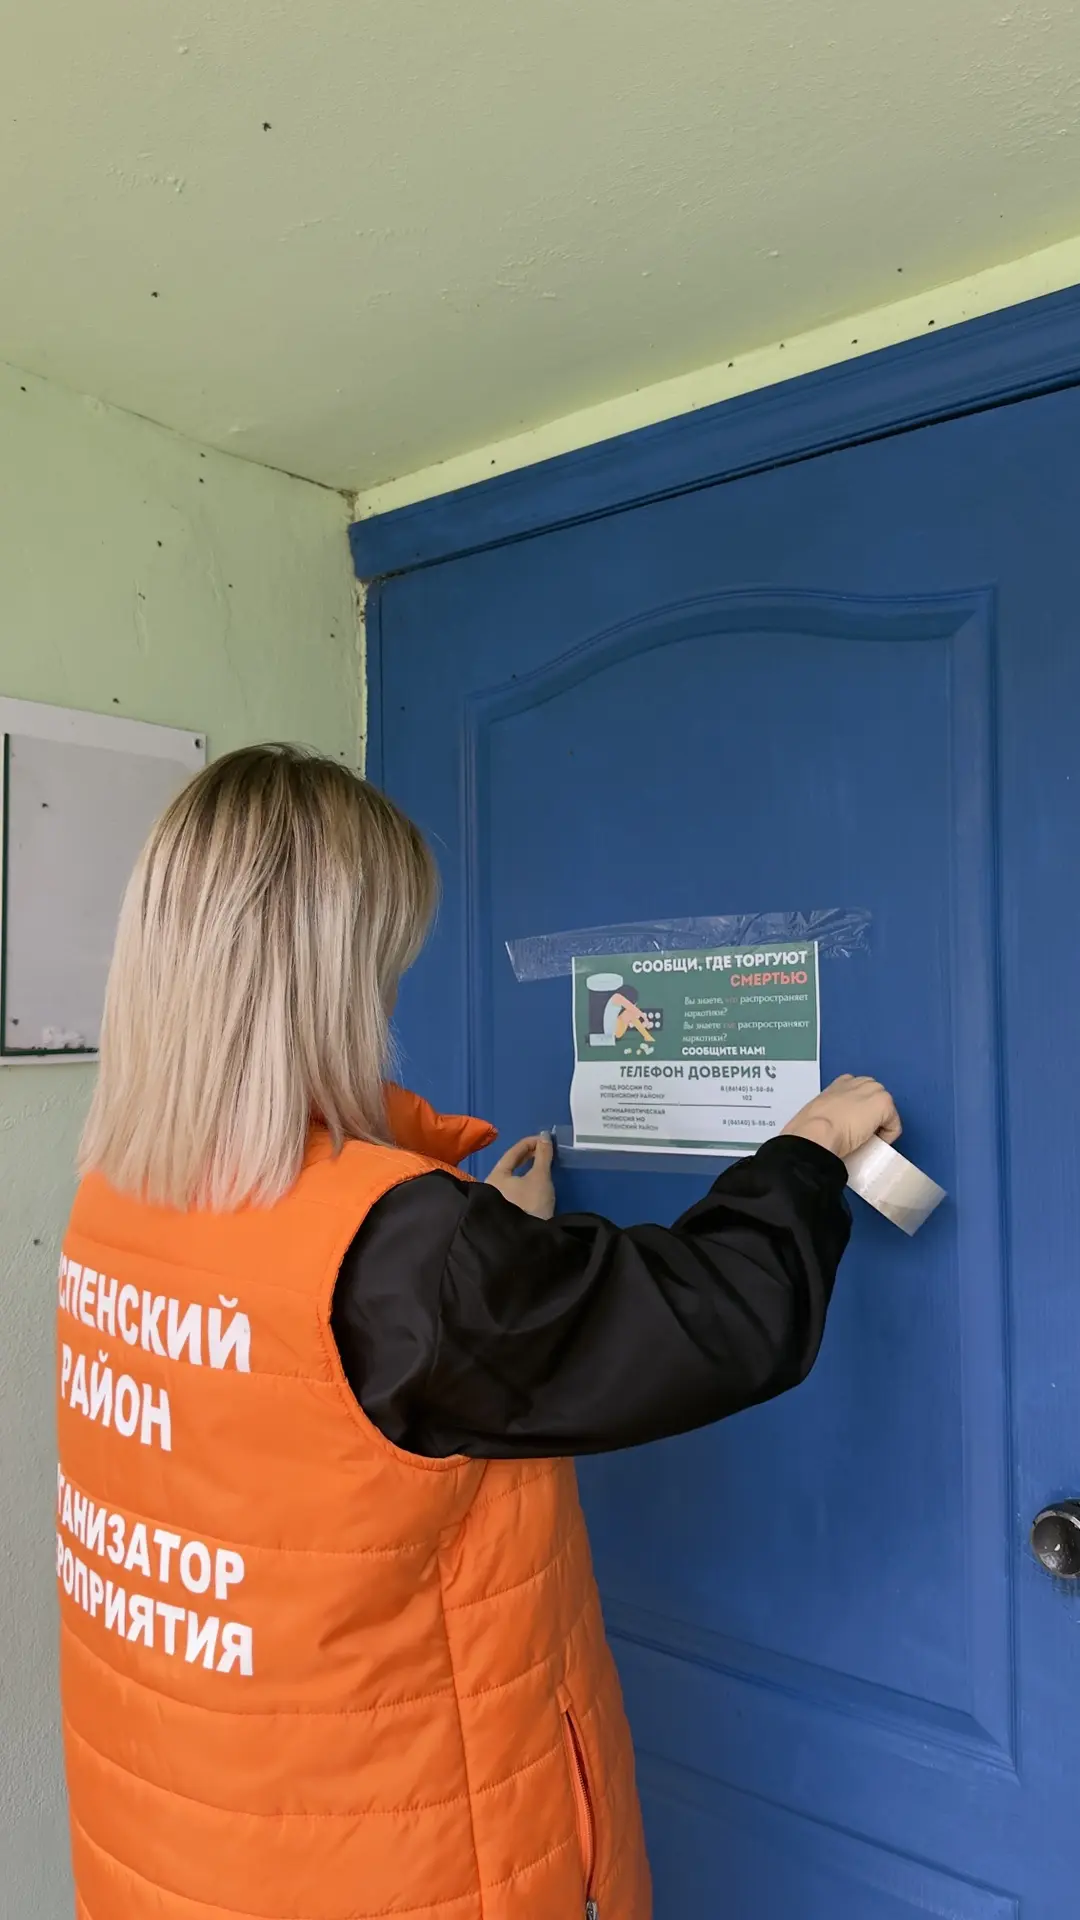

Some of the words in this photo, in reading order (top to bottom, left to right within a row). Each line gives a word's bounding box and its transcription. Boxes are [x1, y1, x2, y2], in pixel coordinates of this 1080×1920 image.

[631, 957, 703, 974] СООБЩИ,
[705, 954, 733, 973] ГДЕ
[734, 950, 808, 968] ТОРГУЮТ
[730, 970, 808, 988] СМЕРТЬЮ
[684, 996, 696, 1006] Вы
[740, 993, 809, 1005] распространяет
[684, 1007, 728, 1019] наркотики?
[683, 1021, 694, 1030] Вы
[696, 1022, 721, 1030] знаете
[737, 1019, 810, 1031] распространяют
[682, 1033, 728, 1044] наркотики?
[681, 1046, 738, 1057] СООБЩИТЕ
[739, 1046, 766, 1056] НАМ!
[620, 1066, 684, 1079] ТЕЛЕФОН
[688, 1065, 761, 1080] ДОВЕРИЯ
[58, 1251, 252, 1374] СПЕНСКИЙ
[61, 1342, 173, 1452] РАЙОН
[57, 1462, 246, 1601] ГАНИЗАТОР
[56, 1533, 254, 1677] РОПРИЯТИЯ
